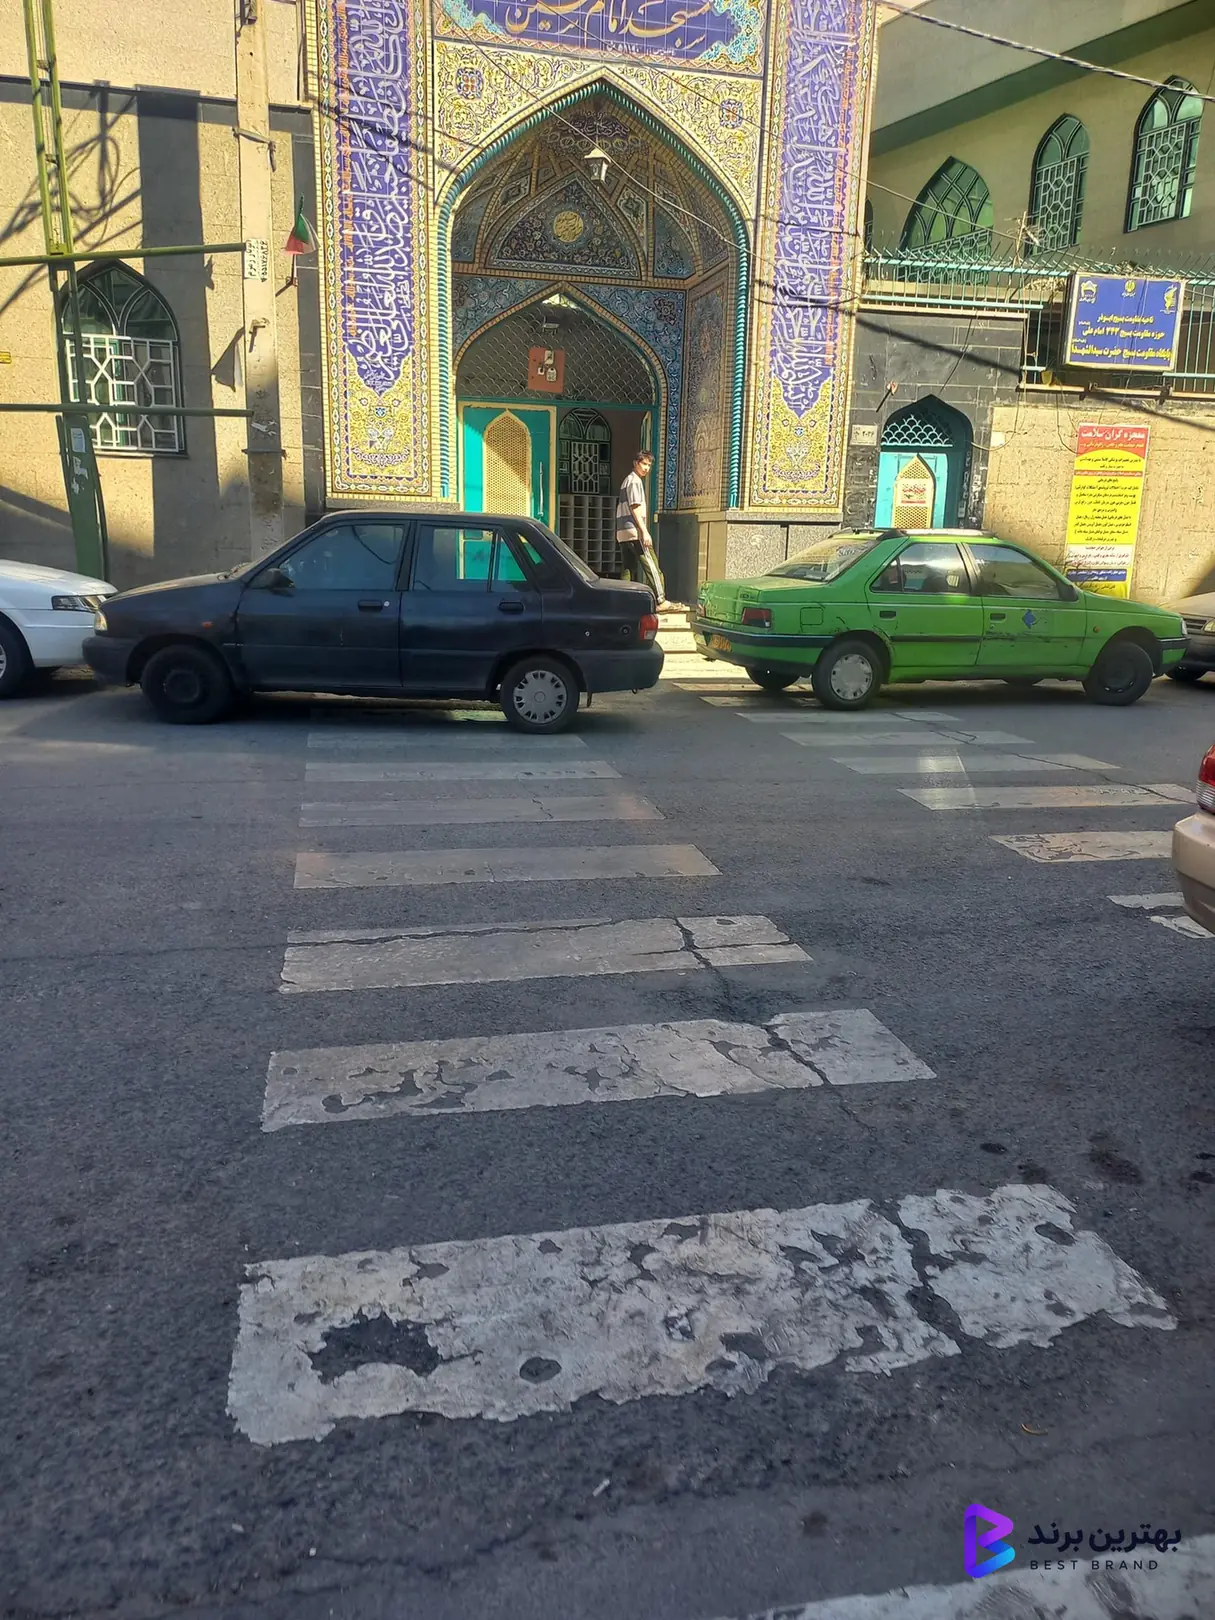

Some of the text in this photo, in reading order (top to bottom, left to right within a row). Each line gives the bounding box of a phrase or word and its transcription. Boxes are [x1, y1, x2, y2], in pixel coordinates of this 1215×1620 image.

[1113, 315, 1125, 323] بسیج
[1093, 327, 1105, 336] امام
[1120, 329, 1132, 338] بسیج
[1133, 329, 1153, 339] مقاومت
[1153, 331, 1165, 340] حوزه
[1104, 346, 1121, 358] حضرت
[1123, 348, 1136, 358] بسیج
[1137, 348, 1156, 359] مقاومت
[1081, 427, 1145, 441] معجزه گران سلامت
